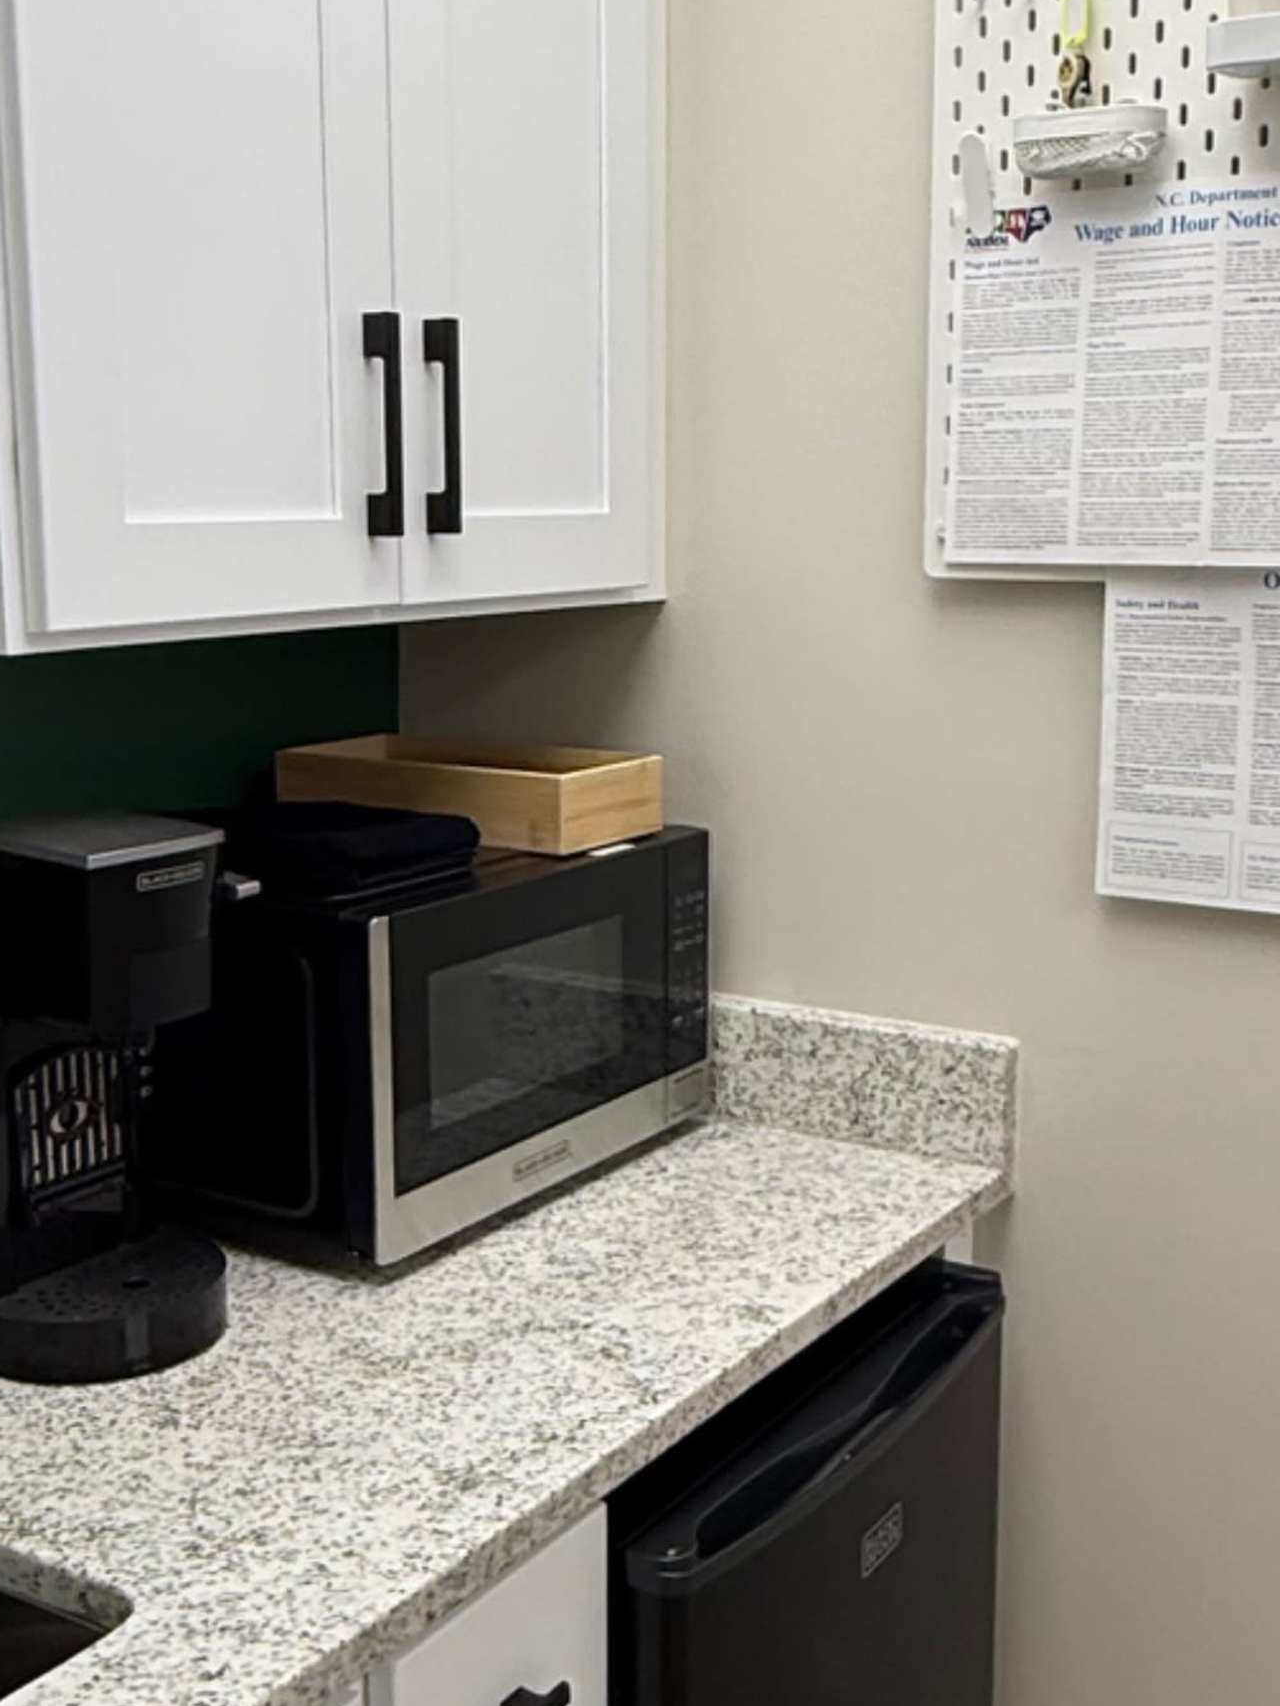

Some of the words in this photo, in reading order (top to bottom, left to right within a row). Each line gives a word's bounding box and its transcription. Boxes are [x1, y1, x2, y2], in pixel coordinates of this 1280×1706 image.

[1191, 186, 1277, 206] Department
[1075, 223, 1124, 243] Wage
[1130, 218, 1163, 237] and
[1170, 214, 1220, 234] Hour
